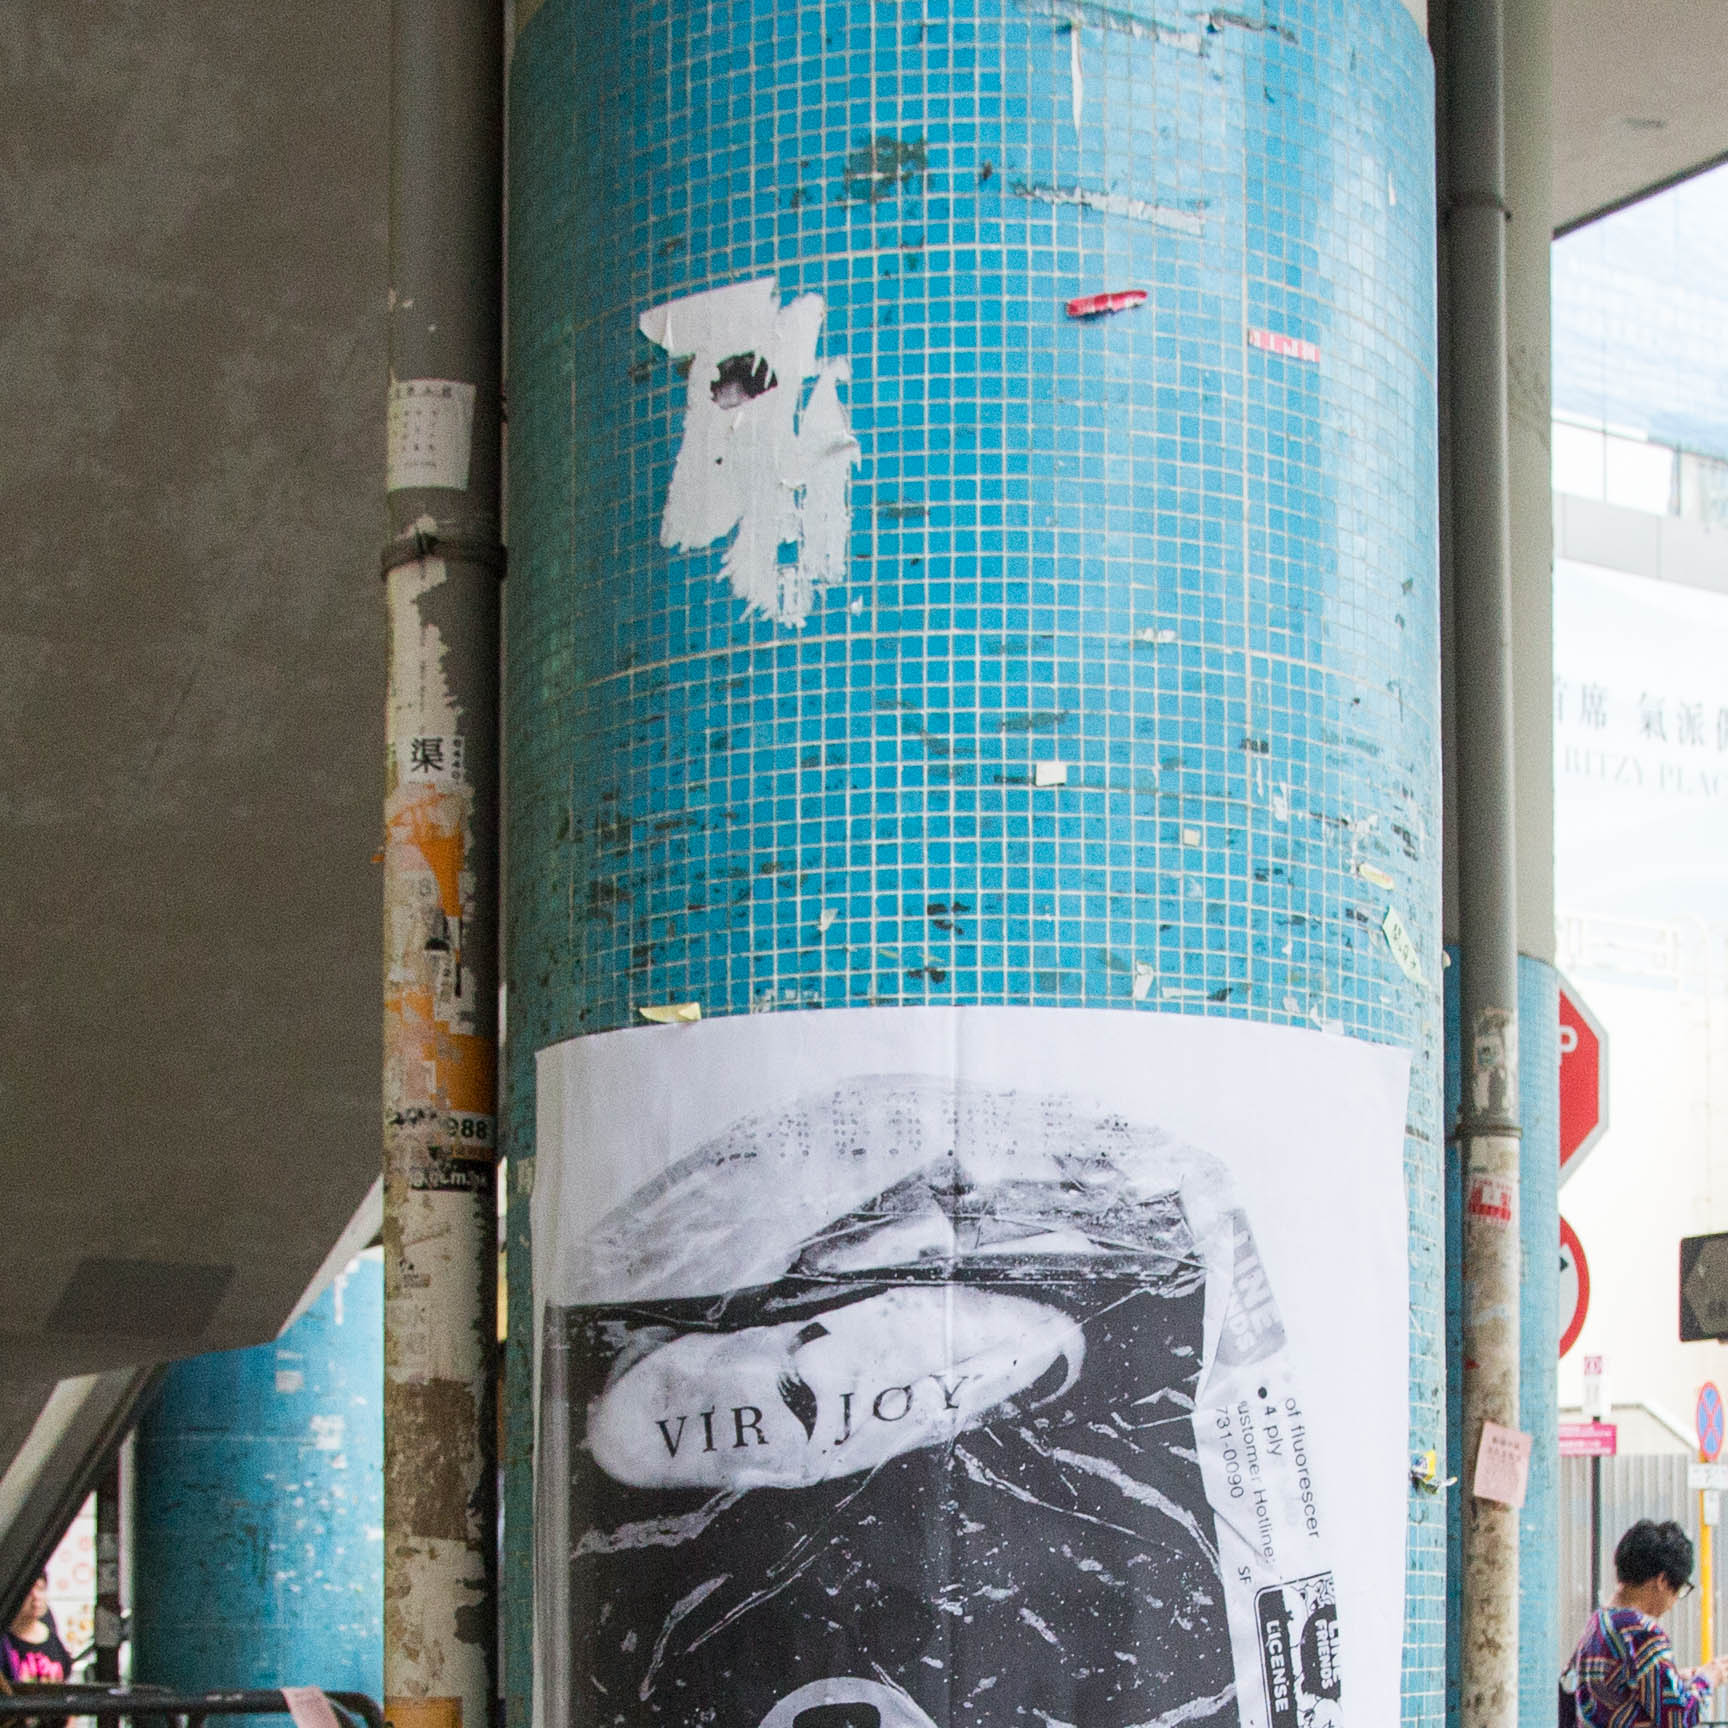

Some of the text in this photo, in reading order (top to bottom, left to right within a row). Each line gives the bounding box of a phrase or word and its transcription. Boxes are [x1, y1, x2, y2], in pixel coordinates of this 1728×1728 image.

[656, 1373, 970, 1459] VIR JOY
[1263, 1405, 1282, 1457] 4 ply
[1284, 1398, 1320, 1538] of fluorescer
[1266, 1620, 1289, 1713] LICENSE
[1315, 1619, 1334, 1690] FRIENDS
